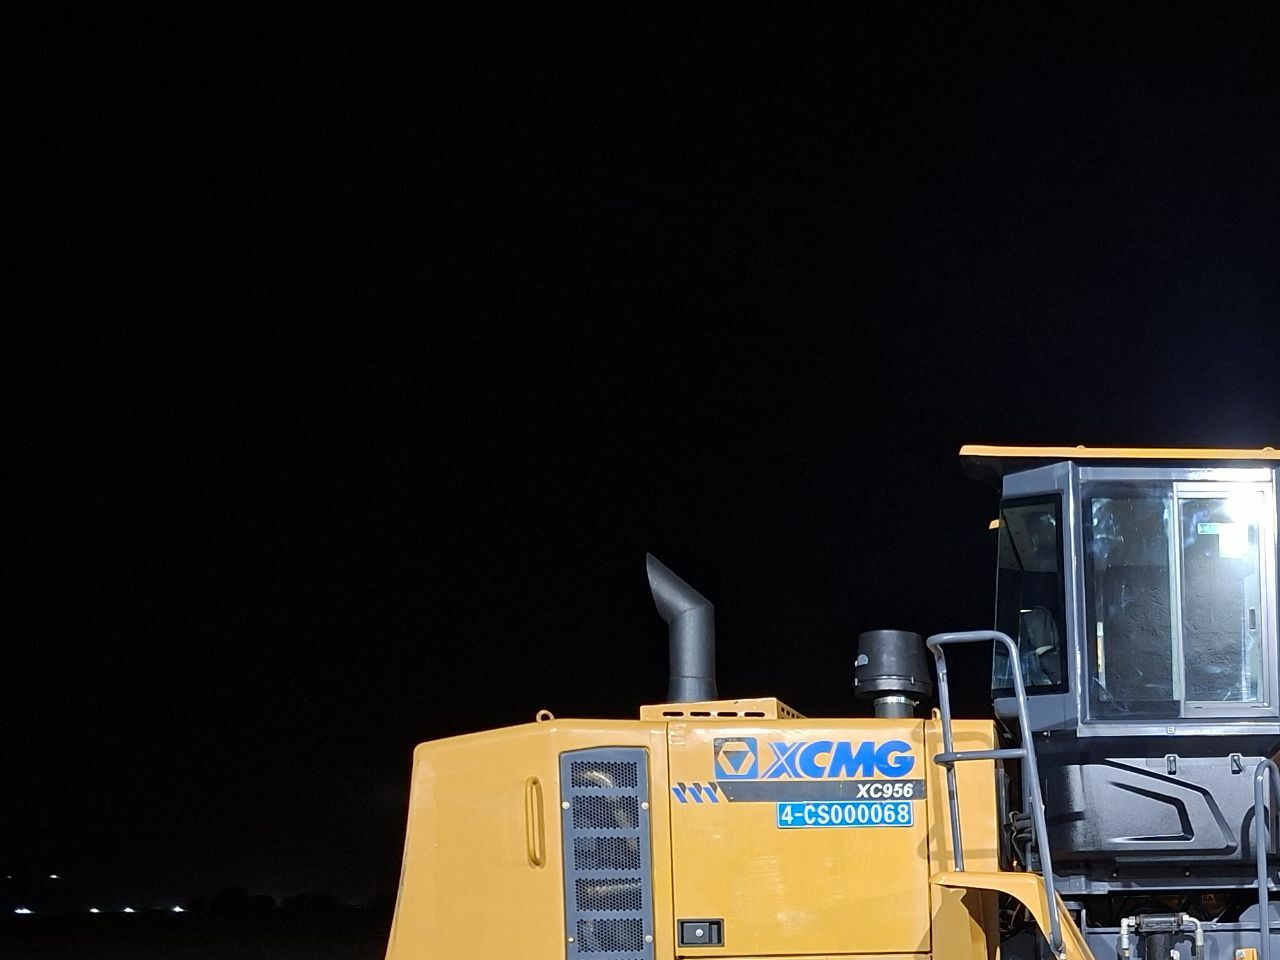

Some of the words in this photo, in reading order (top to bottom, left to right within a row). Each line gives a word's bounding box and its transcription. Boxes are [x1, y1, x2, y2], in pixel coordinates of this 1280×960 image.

[760, 740, 915, 779] XCMG
[856, 783, 914, 799] XC956
[781, 804, 910, 825] 4-CS000068
